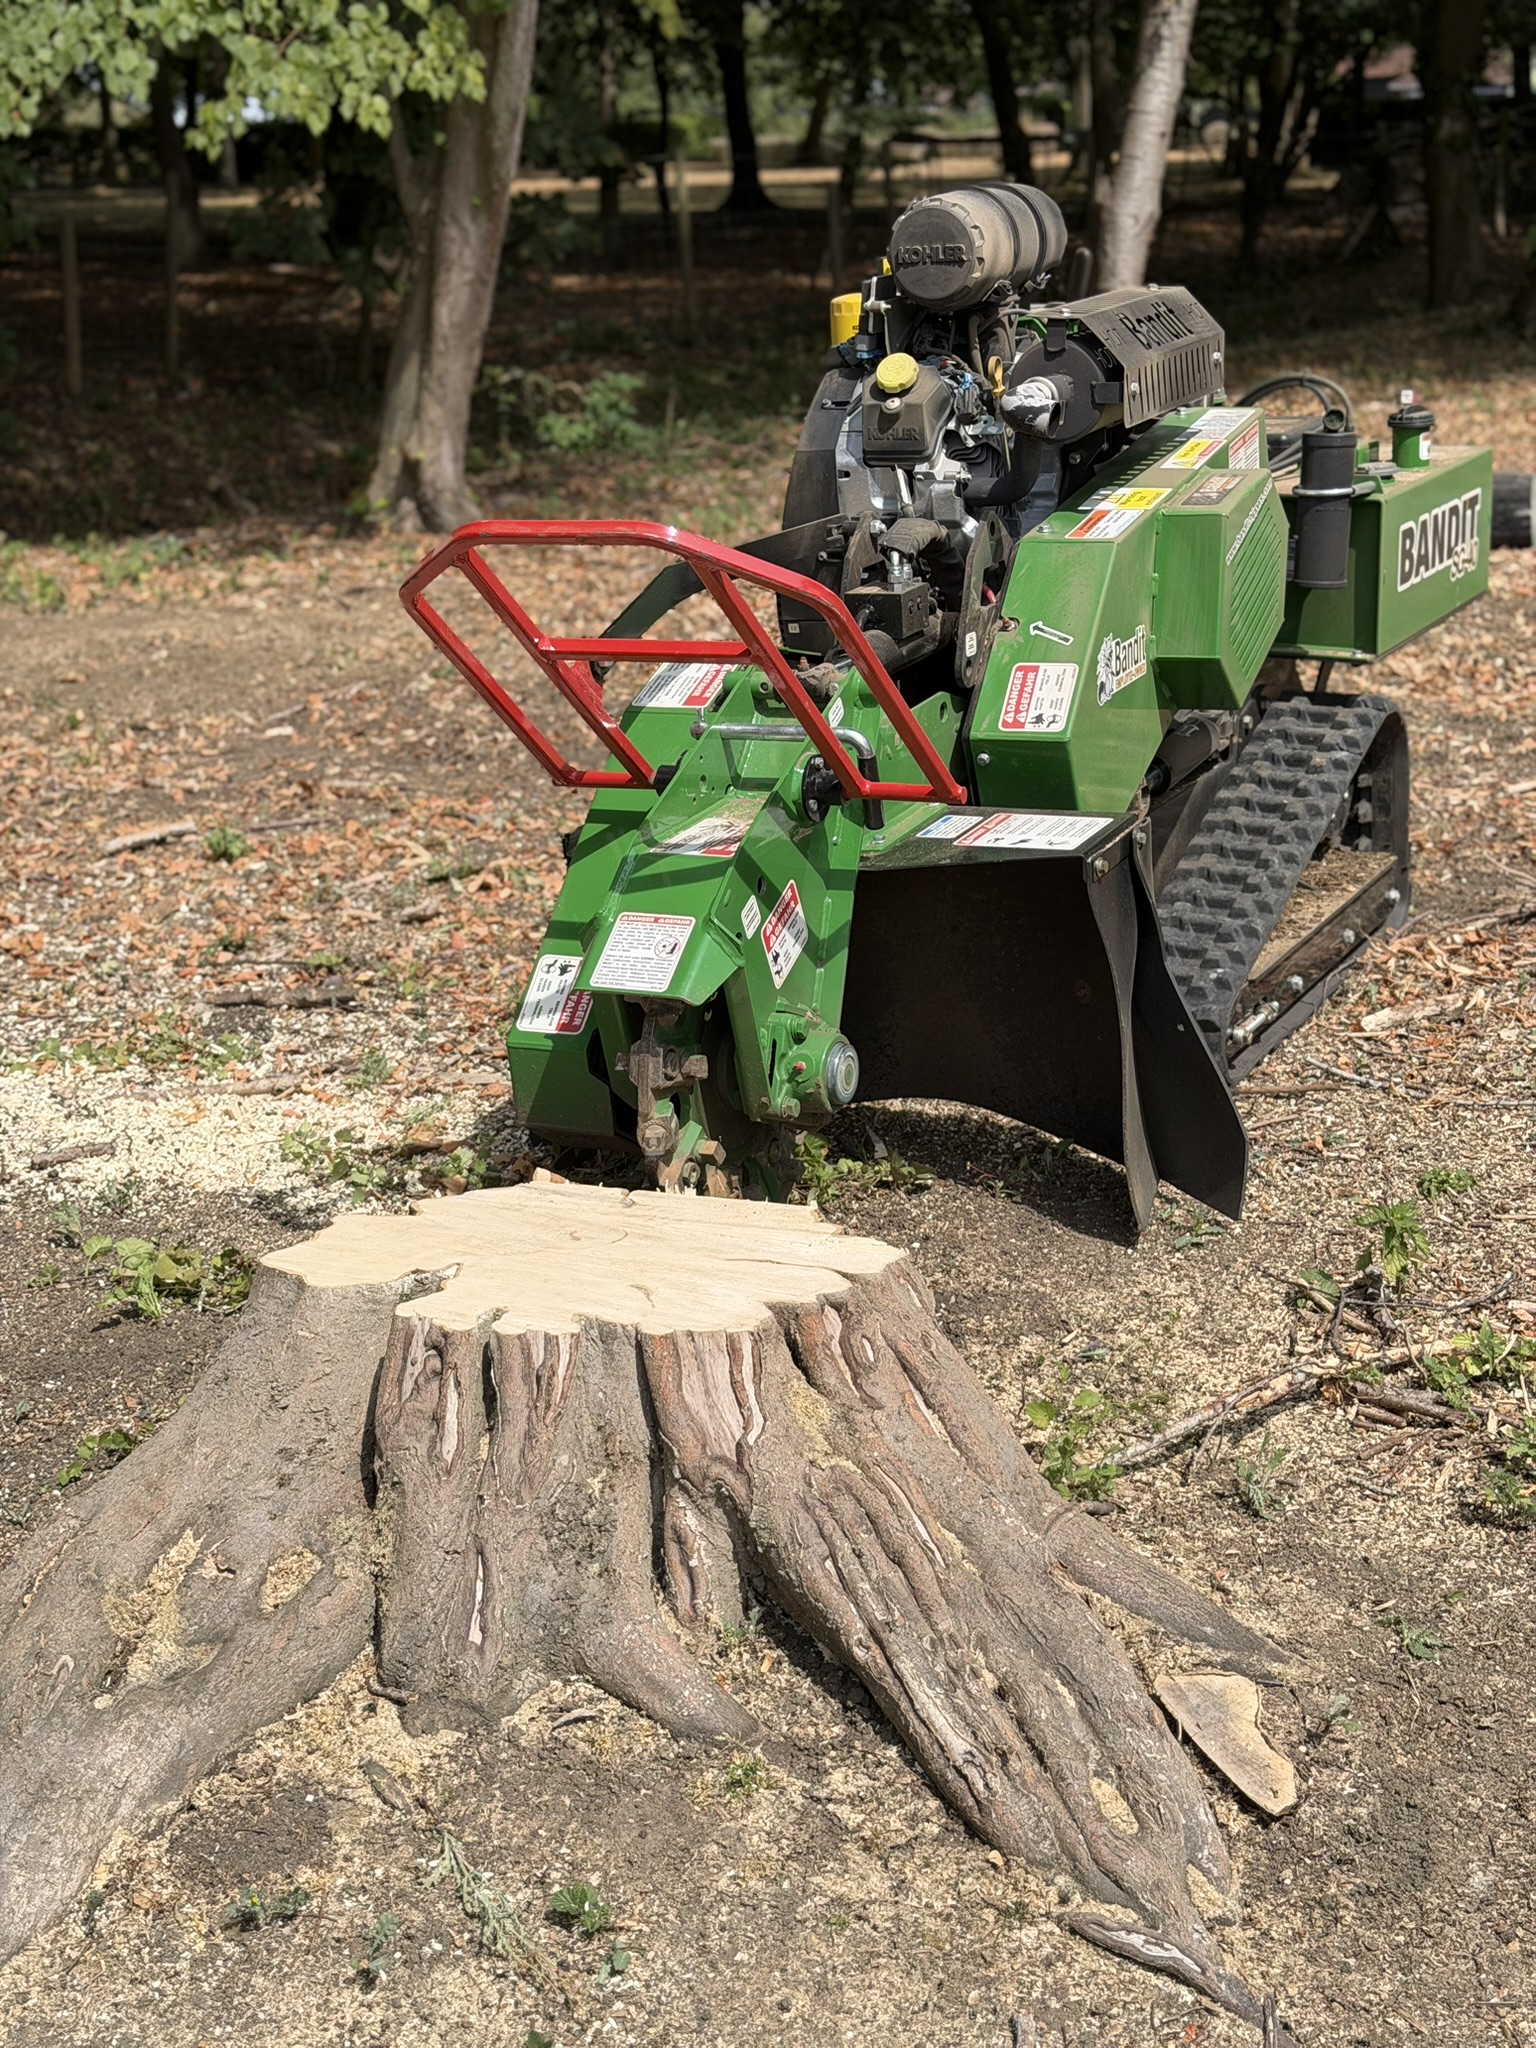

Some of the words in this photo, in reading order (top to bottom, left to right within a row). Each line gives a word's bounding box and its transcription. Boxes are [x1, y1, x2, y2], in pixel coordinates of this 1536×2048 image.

[897, 243, 967, 264] KOHLER
[1116, 301, 1194, 350] Bandit
[867, 427, 920, 441] KOHLER
[1399, 489, 1480, 590] BANDIT
[1114, 625, 1146, 678] Bandit
[1007, 670, 1025, 712] DANGER
[1019, 671, 1037, 712] GEFAHR
[628, 915, 655, 923] DANGER
[770, 888, 793, 926] DANGER
[774, 899, 796, 936] GEFAHR
[560, 991, 579, 1024] FAHR
[572, 991, 592, 1026] NGER
